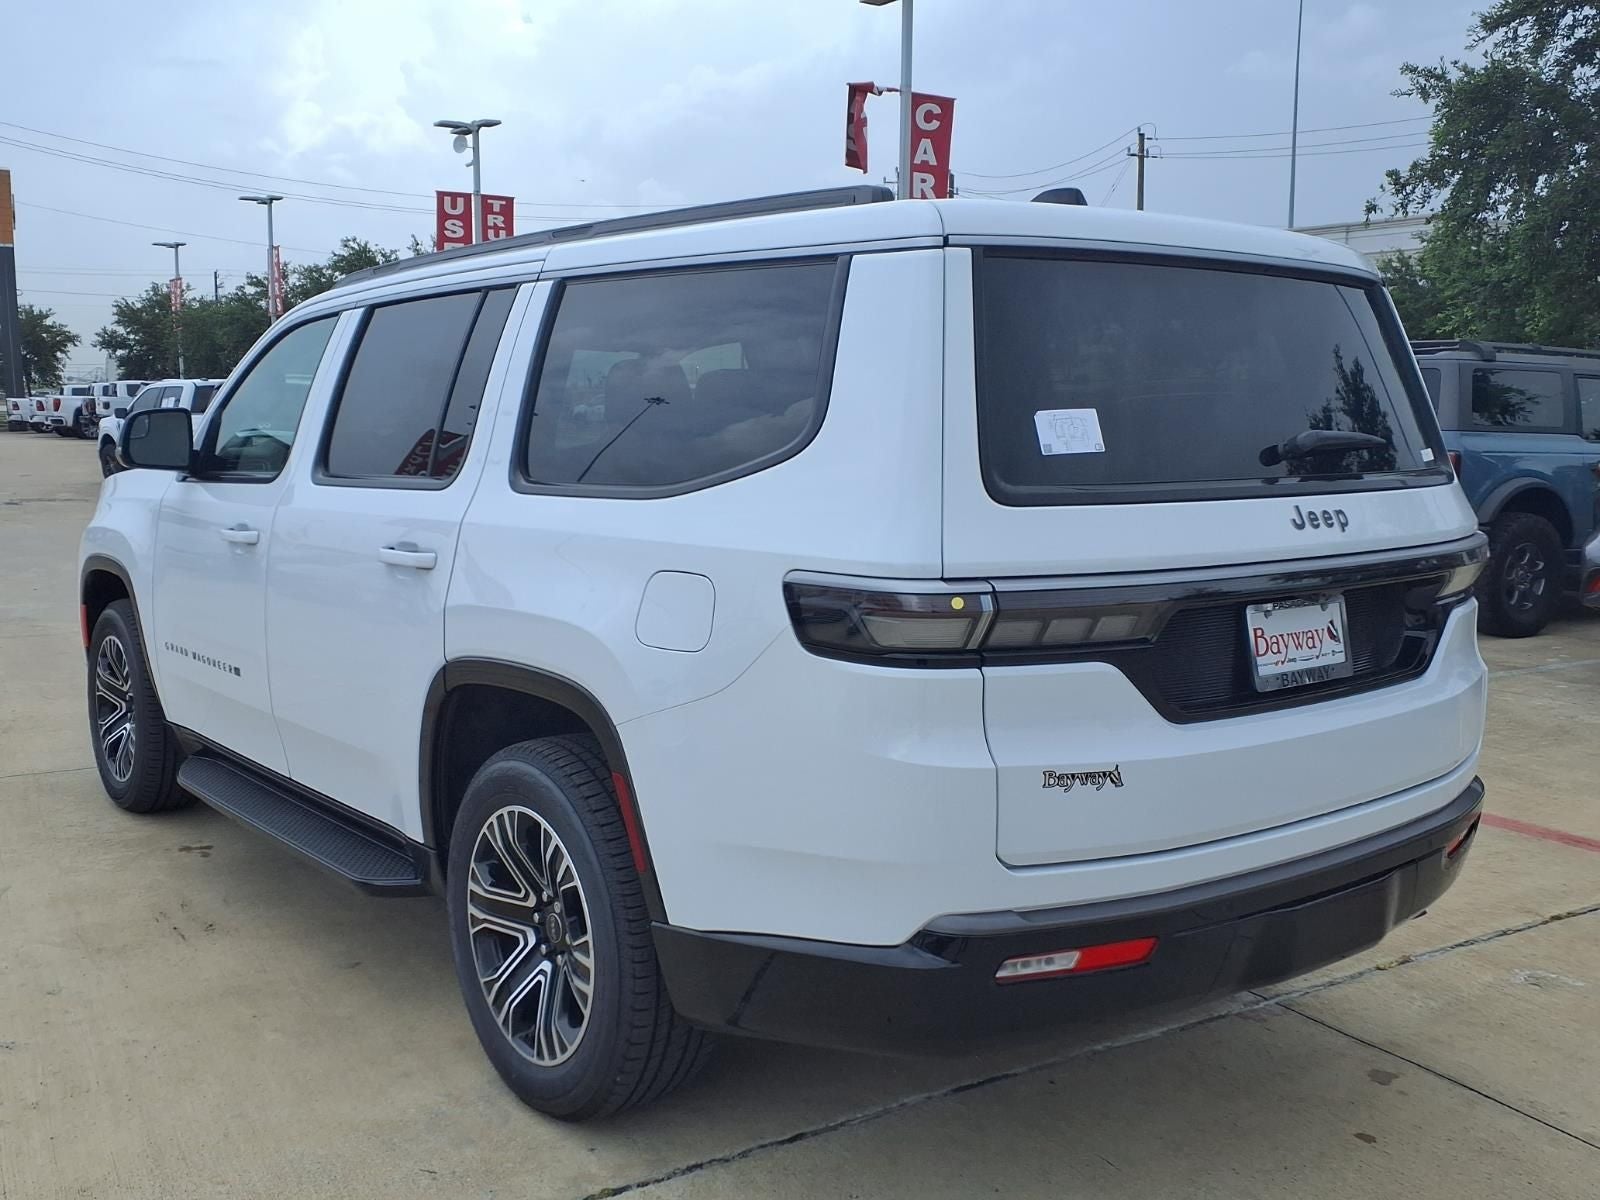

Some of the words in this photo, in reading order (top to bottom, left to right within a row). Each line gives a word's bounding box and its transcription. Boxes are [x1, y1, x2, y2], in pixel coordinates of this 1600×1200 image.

[912, 102, 942, 199] CAR
[486, 199, 507, 241] TRU
[1290, 504, 1349, 533] Jeep
[164, 641, 189, 657] GRAND
[1253, 627, 1325, 665] Bayway
[1281, 664, 1330, 688] BAYWAY
[1042, 768, 1110, 793] Bayway
